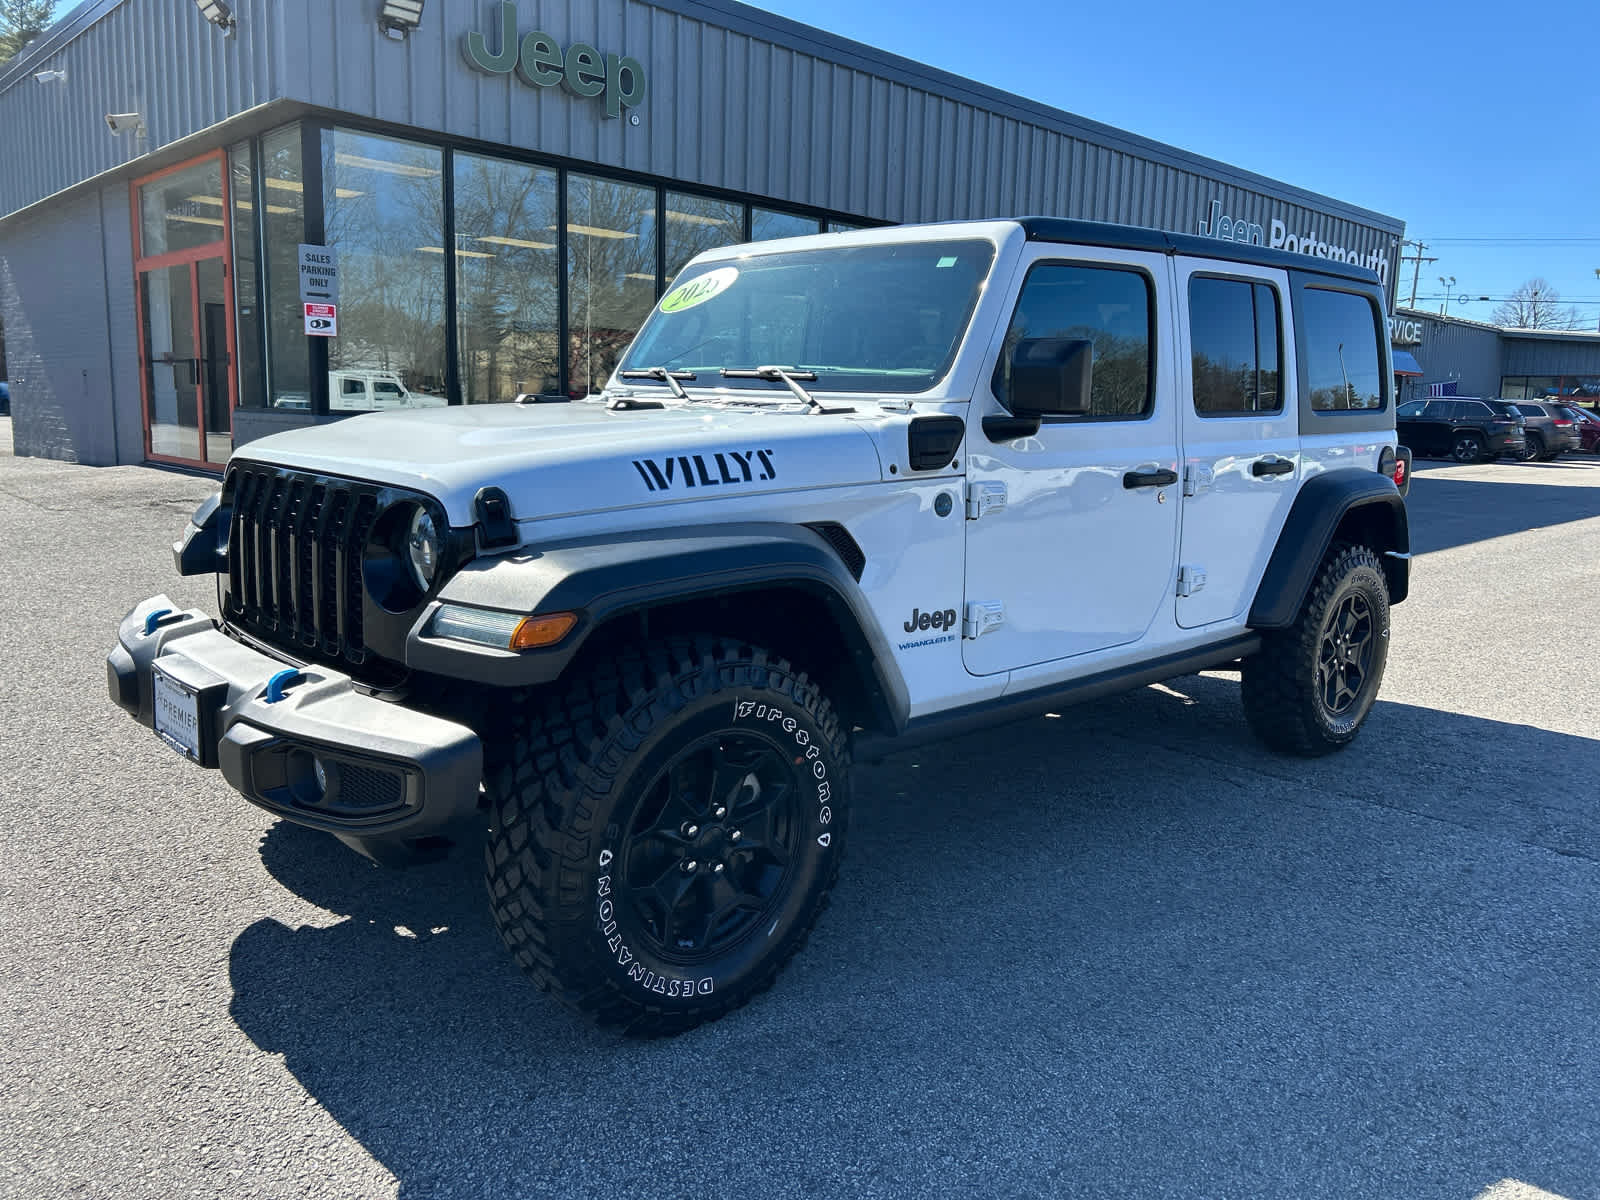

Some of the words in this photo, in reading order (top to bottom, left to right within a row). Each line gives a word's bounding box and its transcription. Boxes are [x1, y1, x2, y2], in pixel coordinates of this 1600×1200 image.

[465, 0, 646, 119] Jeep
[305, 252, 331, 264] SALES
[1270, 218, 1389, 285] Portsmouth
[301, 264, 336, 277] PARKING
[309, 278, 329, 288] ONLY
[631, 449, 776, 491] WILLYS
[903, 608, 957, 633] Jeep
[898, 636, 947, 651] WRANGLER
[162, 697, 197, 729] PREMIER
[738, 701, 832, 825] Firestone
[597, 875, 714, 997] DESTINATION
